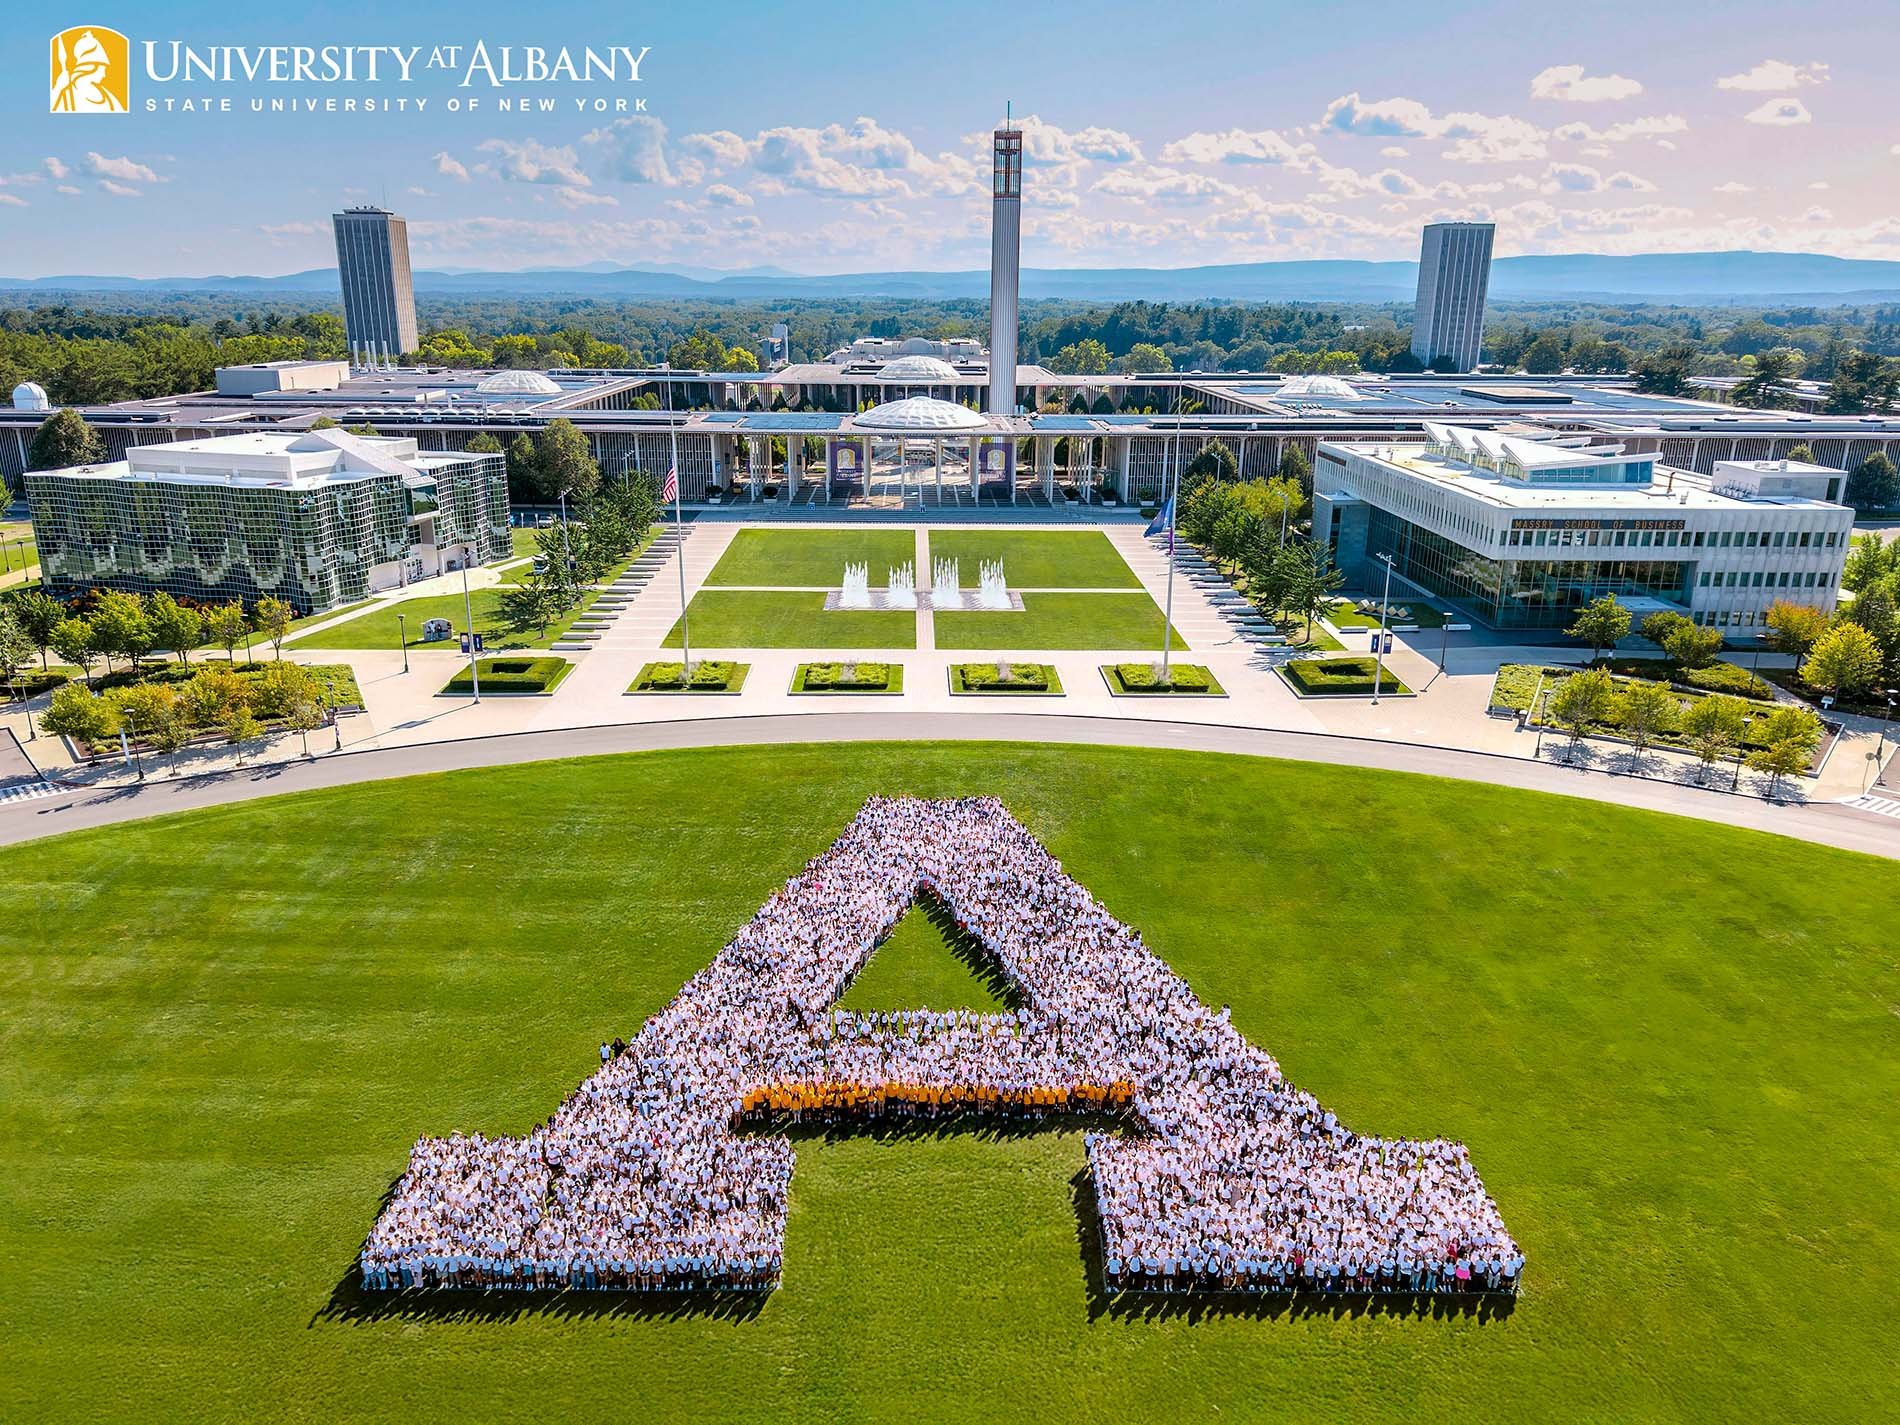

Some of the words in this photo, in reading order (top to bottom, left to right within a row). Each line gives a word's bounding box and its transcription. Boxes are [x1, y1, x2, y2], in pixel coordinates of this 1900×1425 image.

[1514, 520, 1553, 529] MASSRY
[1564, 520, 1601, 529] SCHOOL
[1612, 520, 1625, 529] OF
[1634, 520, 1684, 529] BUSINESS
